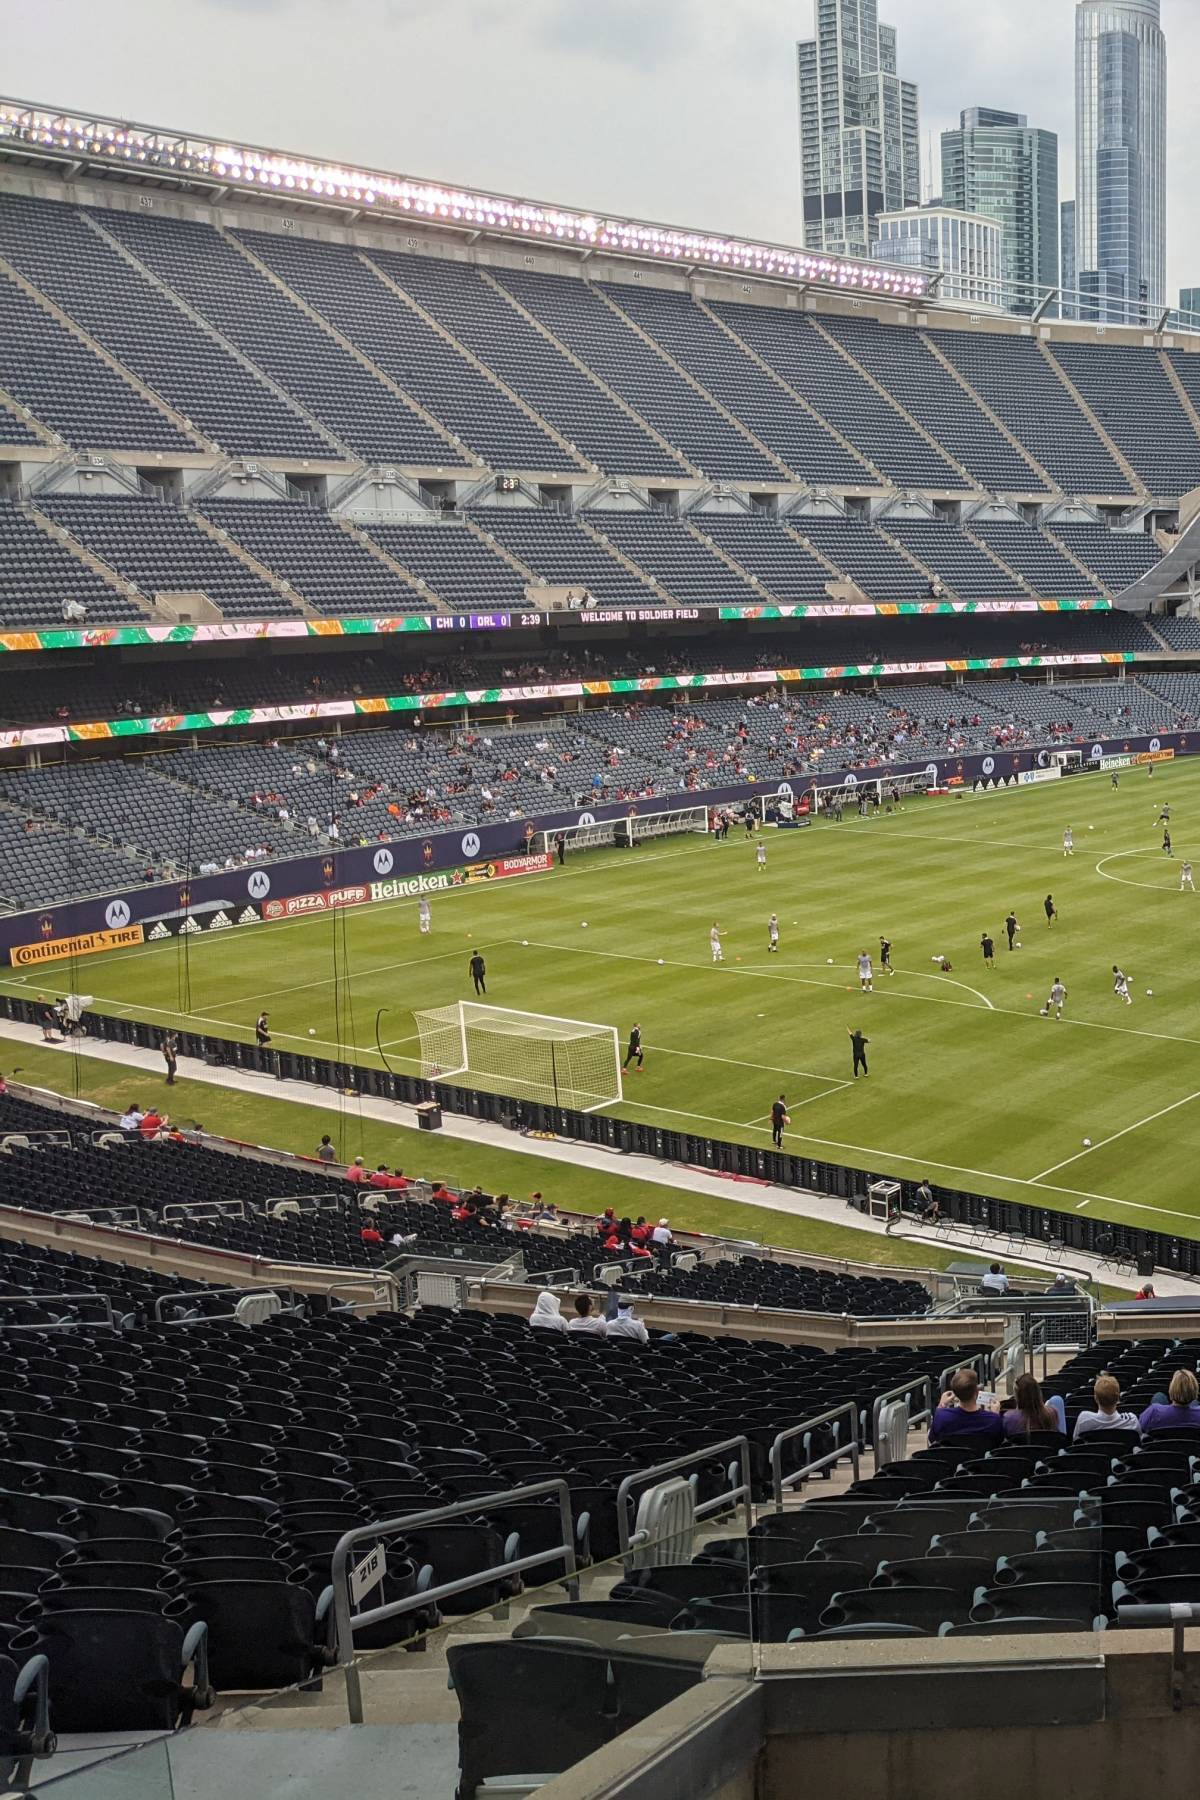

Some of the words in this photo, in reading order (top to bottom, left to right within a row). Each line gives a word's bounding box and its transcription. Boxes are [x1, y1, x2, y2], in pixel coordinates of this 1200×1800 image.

[436, 617, 453, 628] CHI
[459, 616, 466, 628] 0
[477, 615, 496, 627] ORL
[501, 615, 507, 626] 0
[521, 614, 540, 625] 2:39
[580, 611, 623, 622] WELCOME
[625, 610, 636, 620] TO
[639, 609, 673, 620] SOLDIER
[676, 609, 699, 619] FIELD
[1100, 757, 1131, 770] Heineken
[503, 854, 548, 870] BODYARMOR
[371, 873, 449, 901] Heineken
[328, 887, 367, 905] PUFF
[287, 895, 325, 914] PIZZA
[209, 919, 233, 930] adidas
[238, 913, 261, 924] adidas
[148, 930, 172, 940] adidas
[178, 924, 201, 935] adidas
[16, 934, 95, 965] Continental
[109, 929, 140, 944] TIRE
[360, 1555, 378, 1583] 218
